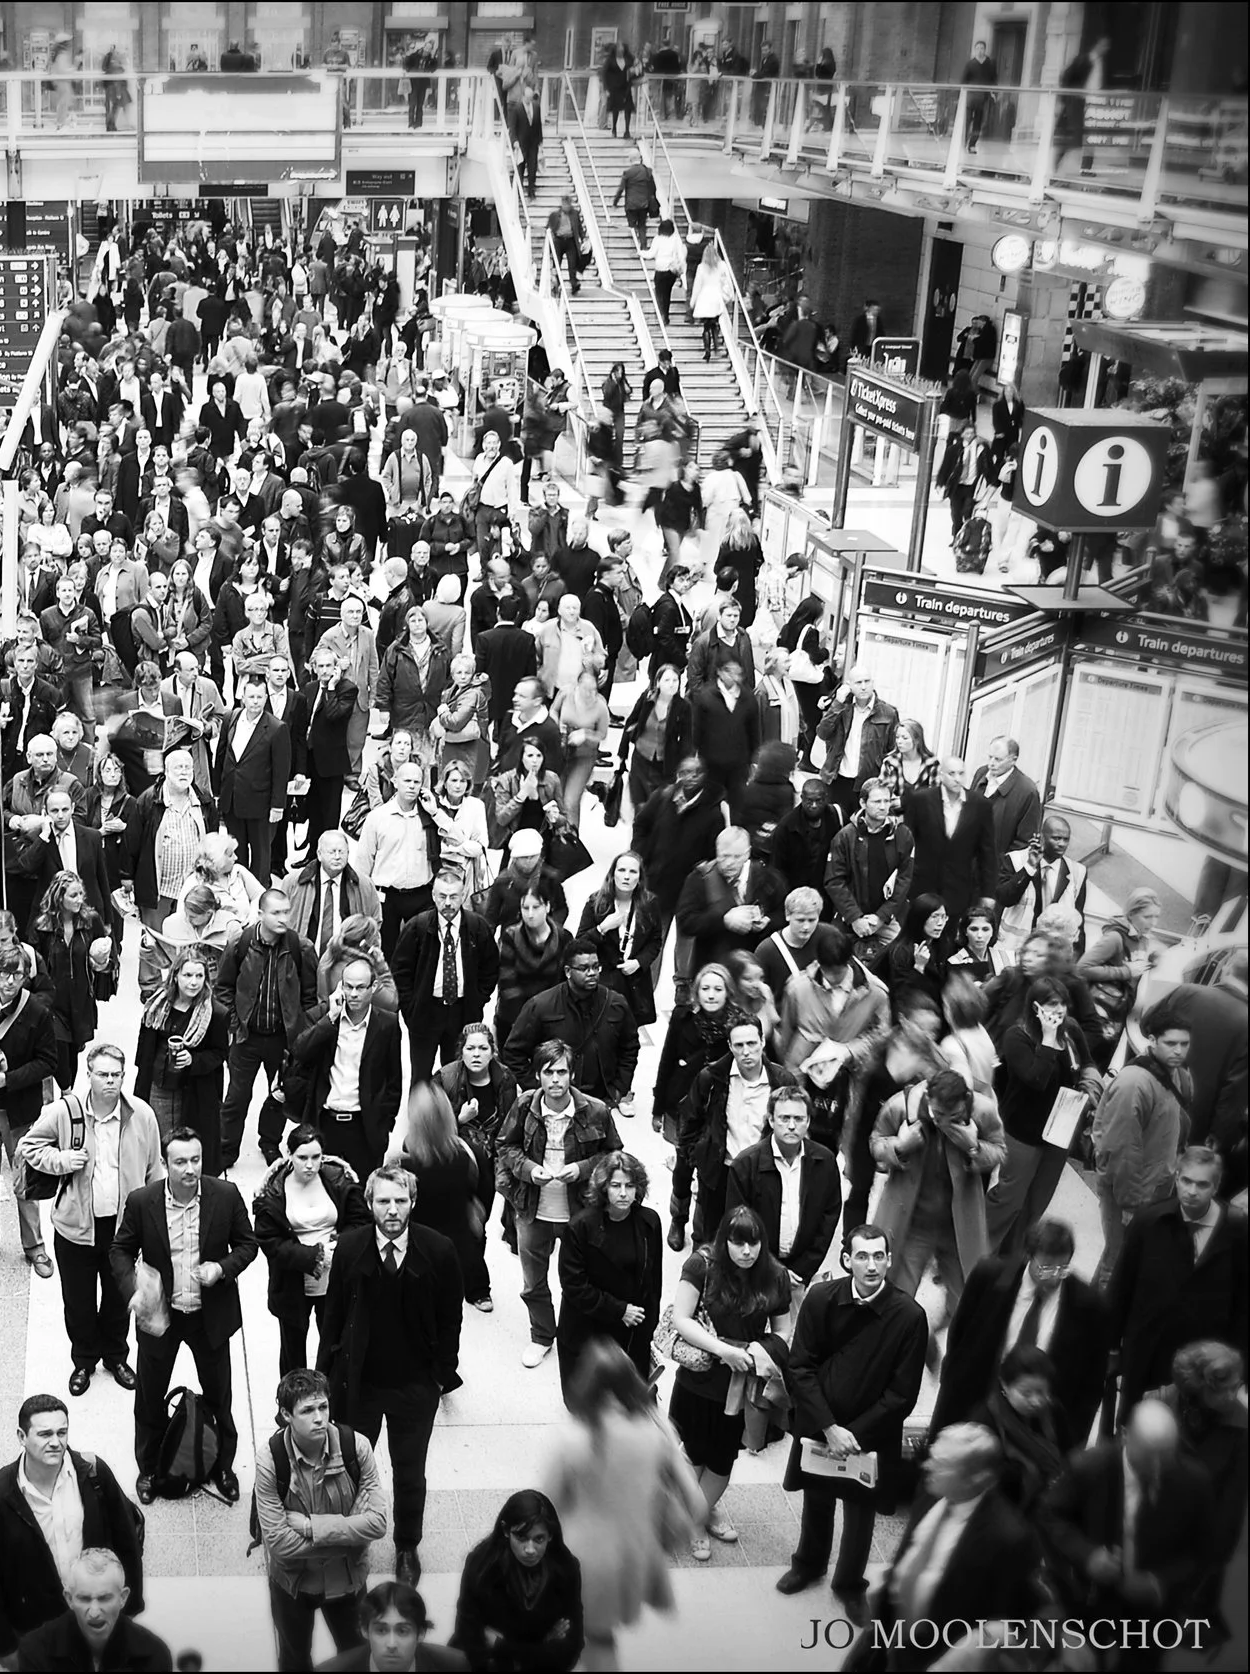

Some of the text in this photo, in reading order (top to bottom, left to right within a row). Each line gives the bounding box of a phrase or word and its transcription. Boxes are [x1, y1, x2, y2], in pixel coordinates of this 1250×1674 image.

[151, 211, 173, 219] Toilets
[915, 594, 1010, 623] Train departures
[884, 636, 912, 647] Departure
[1010, 633, 1055, 661] Train departures
[1137, 633, 1245, 665] Train departures
